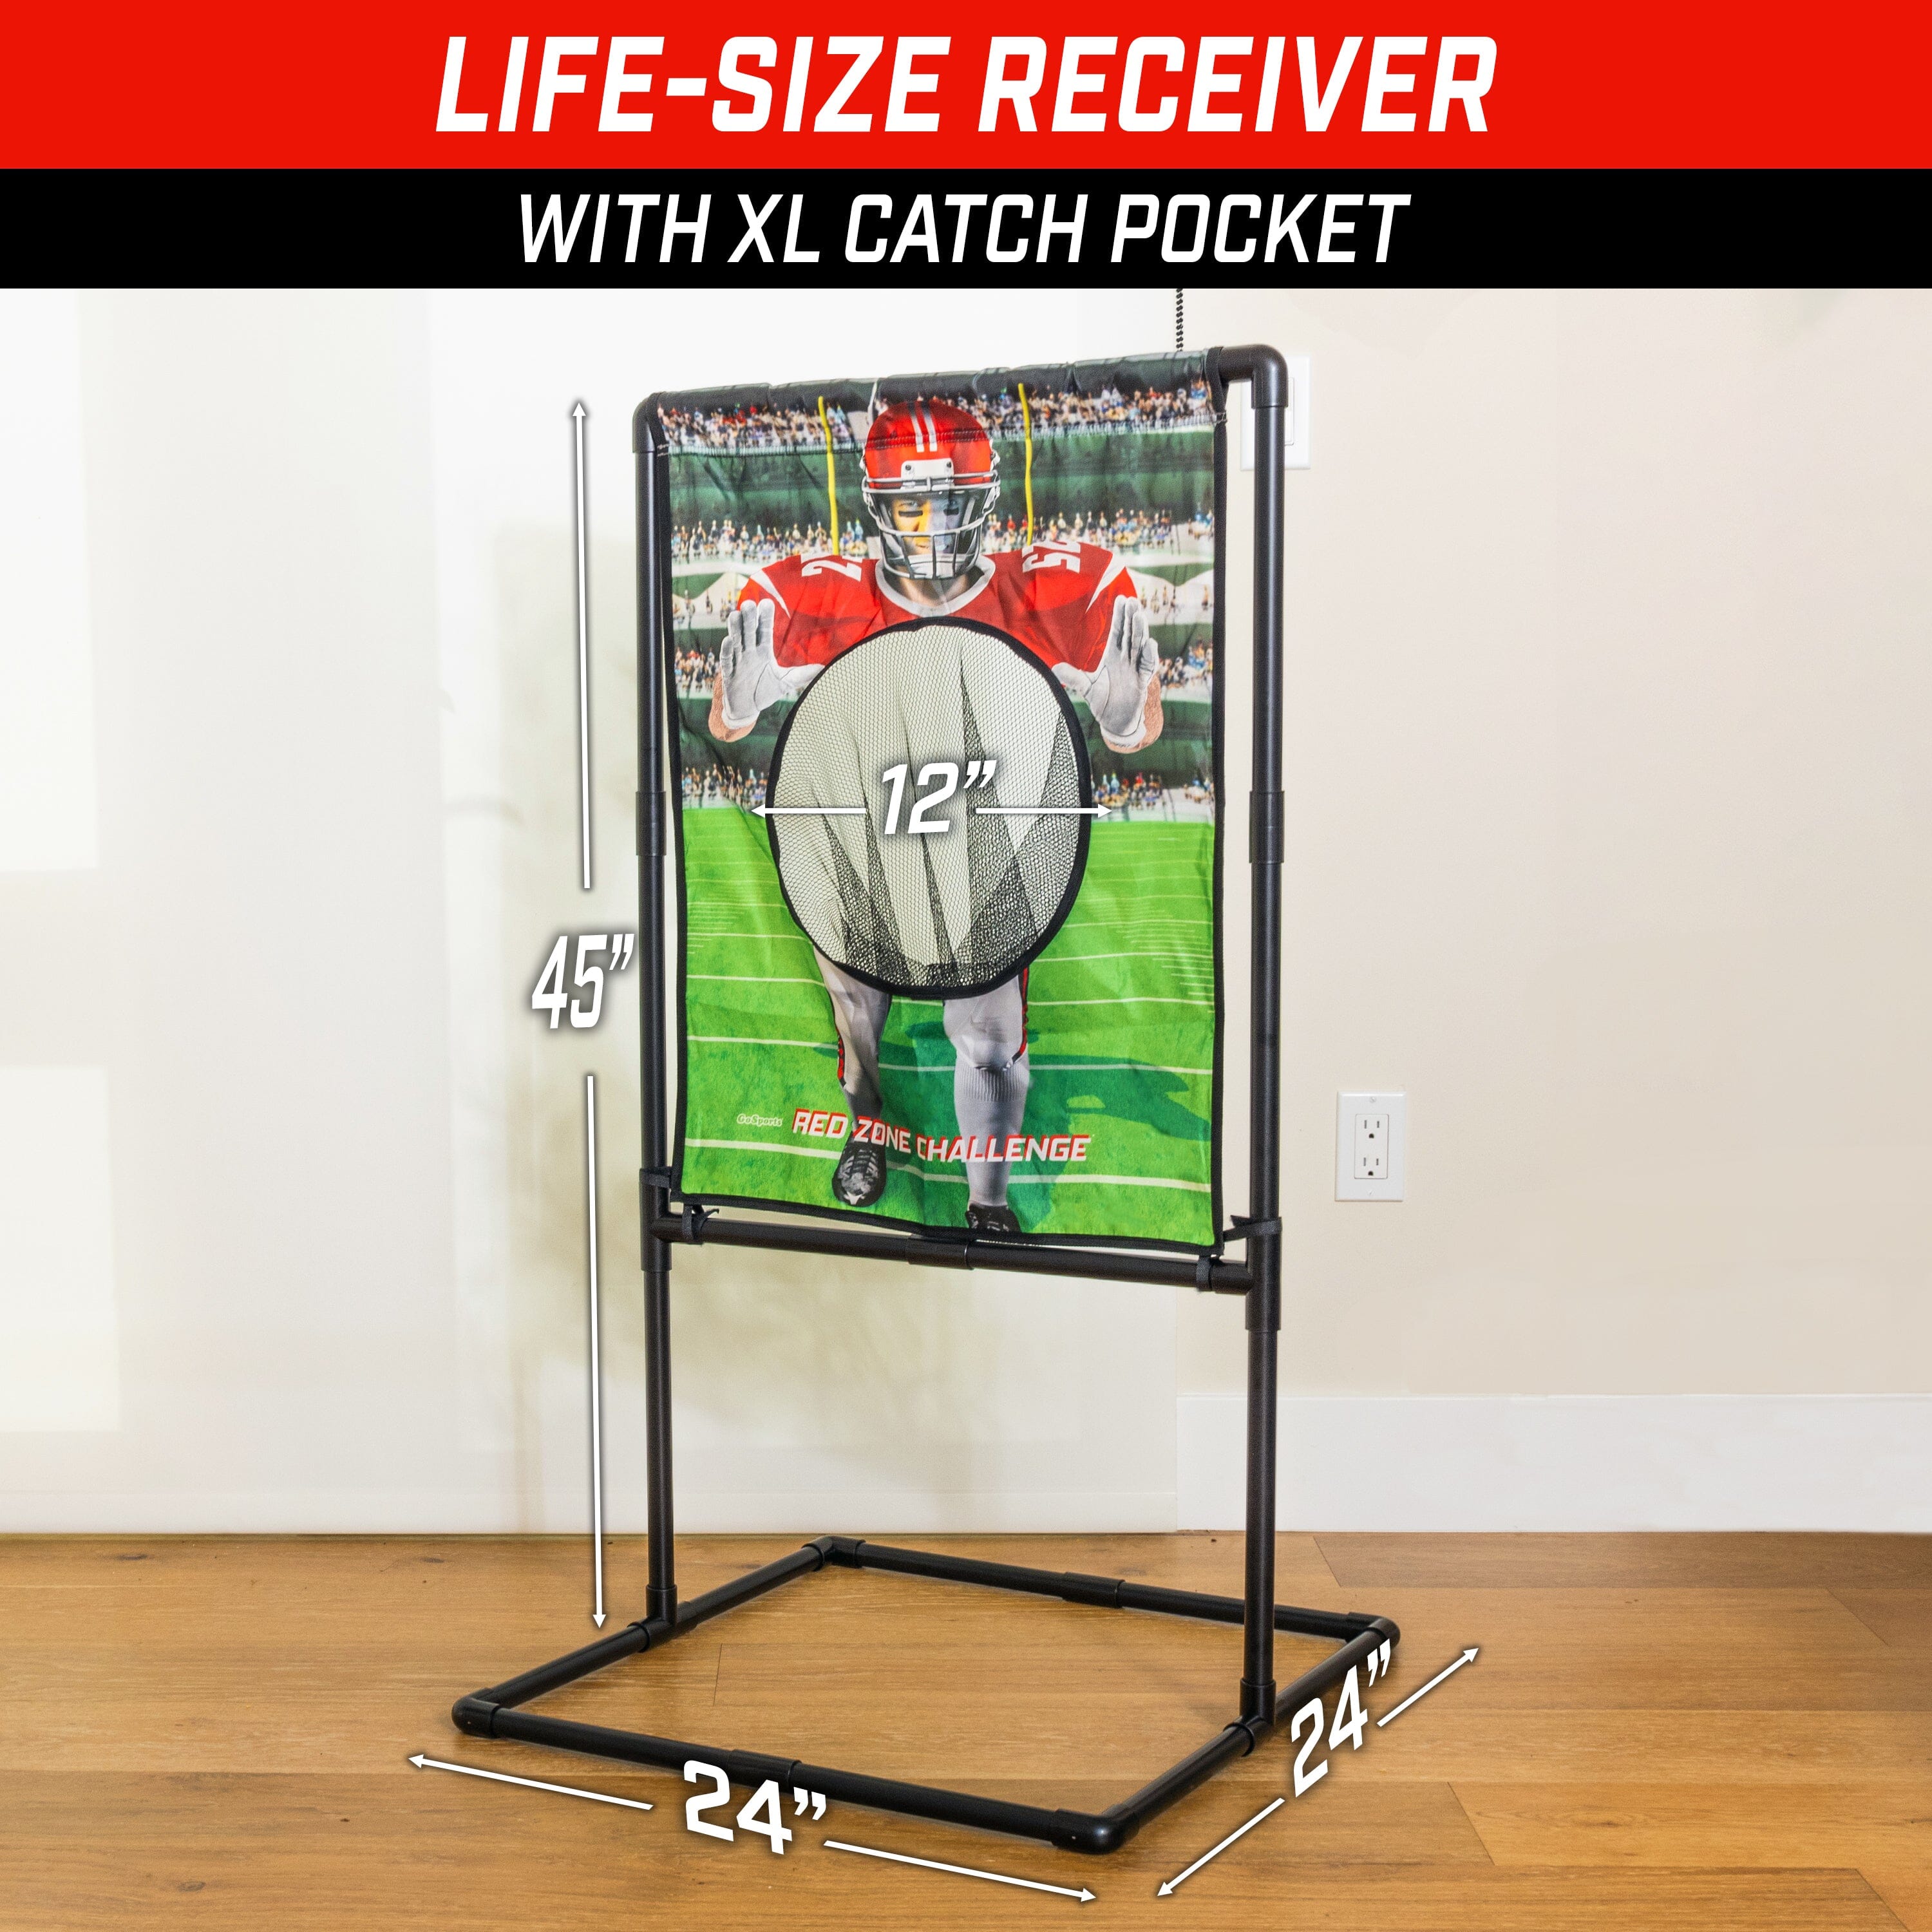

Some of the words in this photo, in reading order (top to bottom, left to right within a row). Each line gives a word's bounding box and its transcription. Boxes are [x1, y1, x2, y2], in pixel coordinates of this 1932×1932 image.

[736, 1113, 783, 1127] GoSports
[791, 1107, 849, 1139] RED
[853, 1115, 911, 1154] ZONE
[915, 1134, 1092, 1162] CHALLENGE
